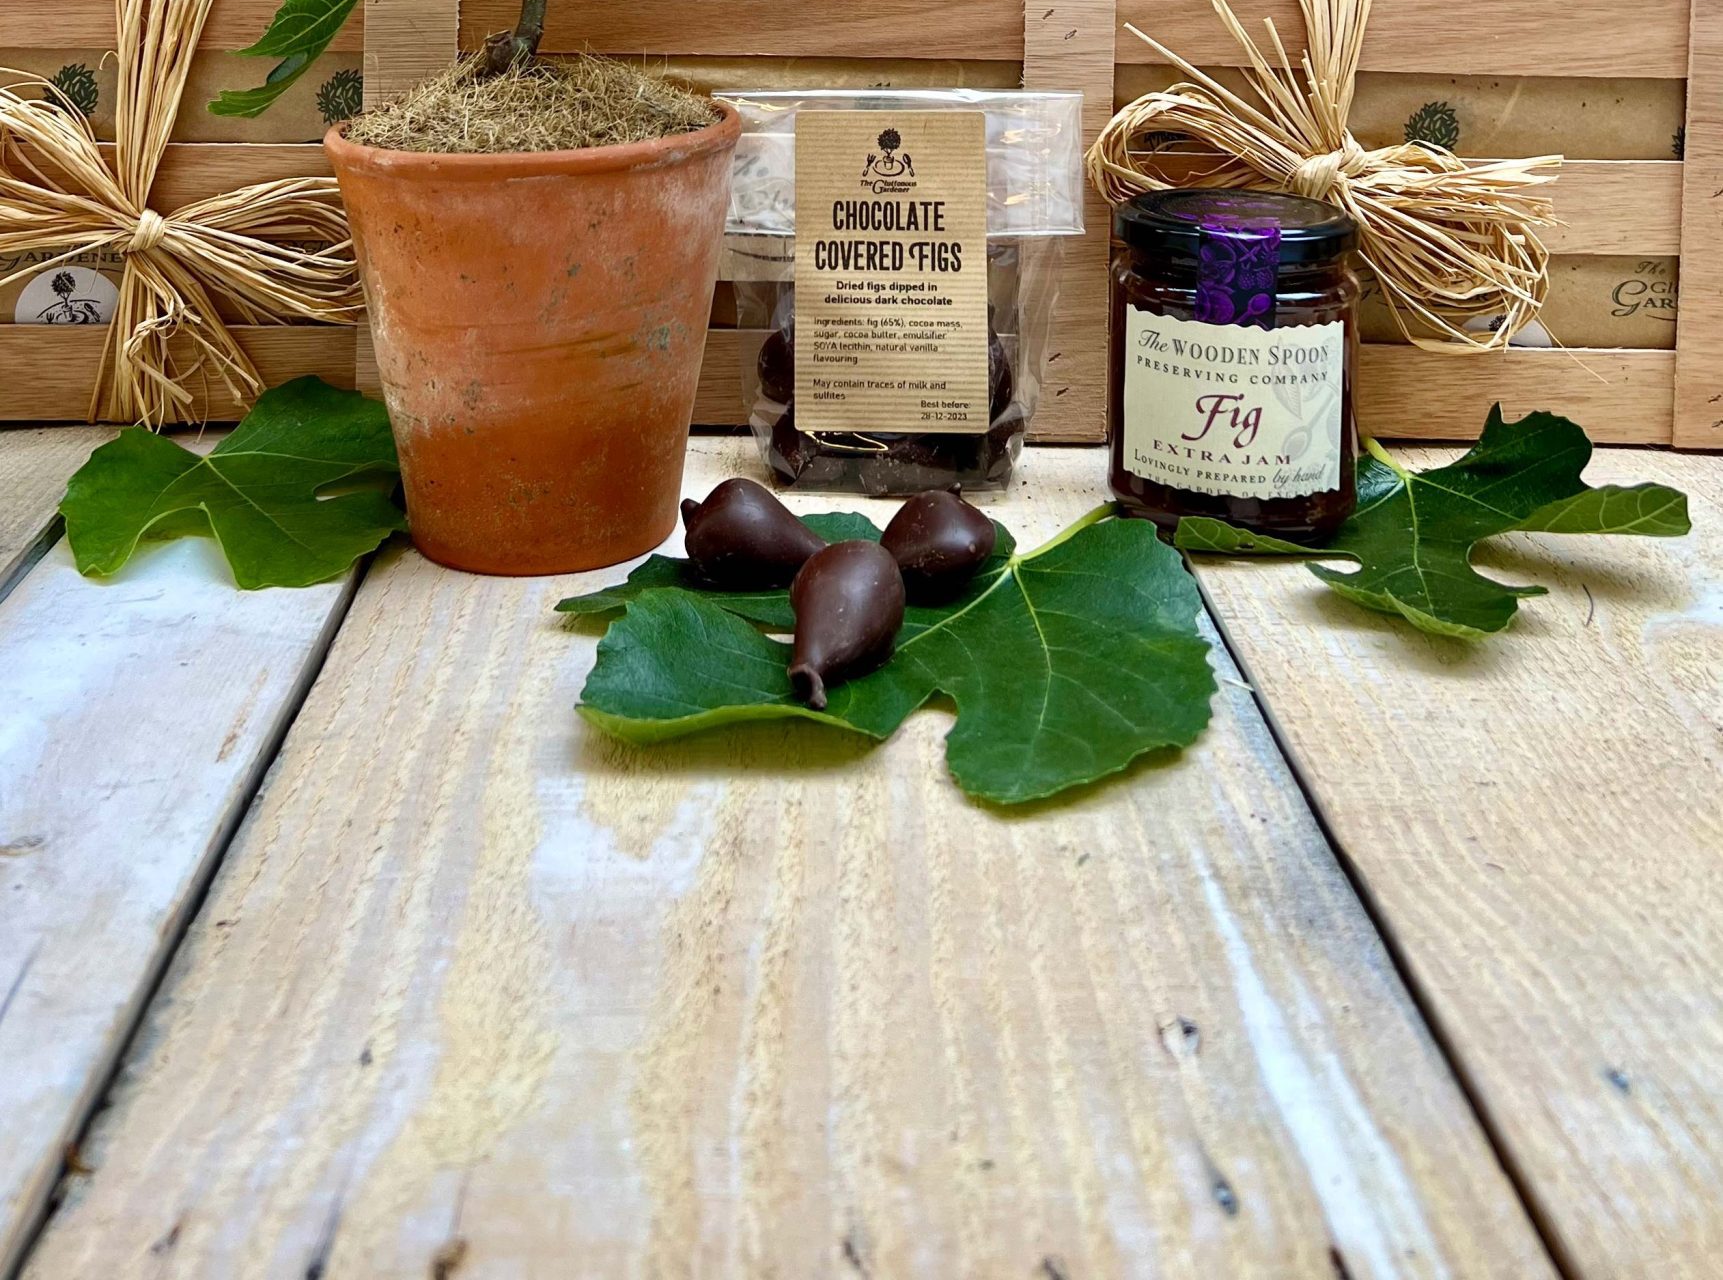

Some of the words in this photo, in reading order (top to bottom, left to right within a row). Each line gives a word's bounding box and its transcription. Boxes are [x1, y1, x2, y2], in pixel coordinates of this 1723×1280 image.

[860, 179, 873, 187] The
[832, 201, 946, 231] CHOCOLATE
[815, 240, 904, 271] COVERED
[908, 241, 962, 272] FIGS
[1635, 260, 1666, 275] The
[836, 280, 865, 291] Dried
[866, 280, 886, 293] figs
[889, 281, 925, 293] dipped
[927, 281, 938, 292] in
[824, 295, 872, 305] delicious
[874, 295, 899, 305] dark
[901, 295, 953, 306] chocolate
[867, 318, 879, 328] fig
[908, 320, 935, 328] cocoa
[813, 331, 842, 341] sugar,
[843, 331, 869, 339] cocoa
[902, 331, 947, 340] emulsifier
[813, 343, 837, 351] SOYA
[875, 343, 908, 352] natural
[909, 343, 939, 352] vanilla
[1137, 328, 1170, 354] The
[1172, 337, 1261, 366] WOODEN
[1267, 344, 1329, 366] SPOON
[813, 355, 858, 365] flavouring
[1136, 355, 1239, 384] PRESERVING
[1250, 371, 1328, 385] COMPANY
[813, 379, 831, 389] May
[832, 379, 865, 389] contain
[867, 380, 895, 389] traces
[897, 380, 907, 389] of
[908, 380, 928, 390] milk
[929, 381, 947, 390] and
[813, 391, 846, 400] sulfites
[920, 400, 939, 409] Best
[941, 400, 971, 409] before:
[920, 412, 968, 421] 28-12-2023
[1181, 392, 1263, 450] Fig
[1153, 439, 1232, 465] EXTRA
[1241, 453, 1291, 466] JAM
[1134, 448, 1190, 476] LOVINGLY
[1196, 469, 1267, 484] PREPARED
[1272, 468, 1291, 490] by
[1290, 463, 1327, 483] hand
